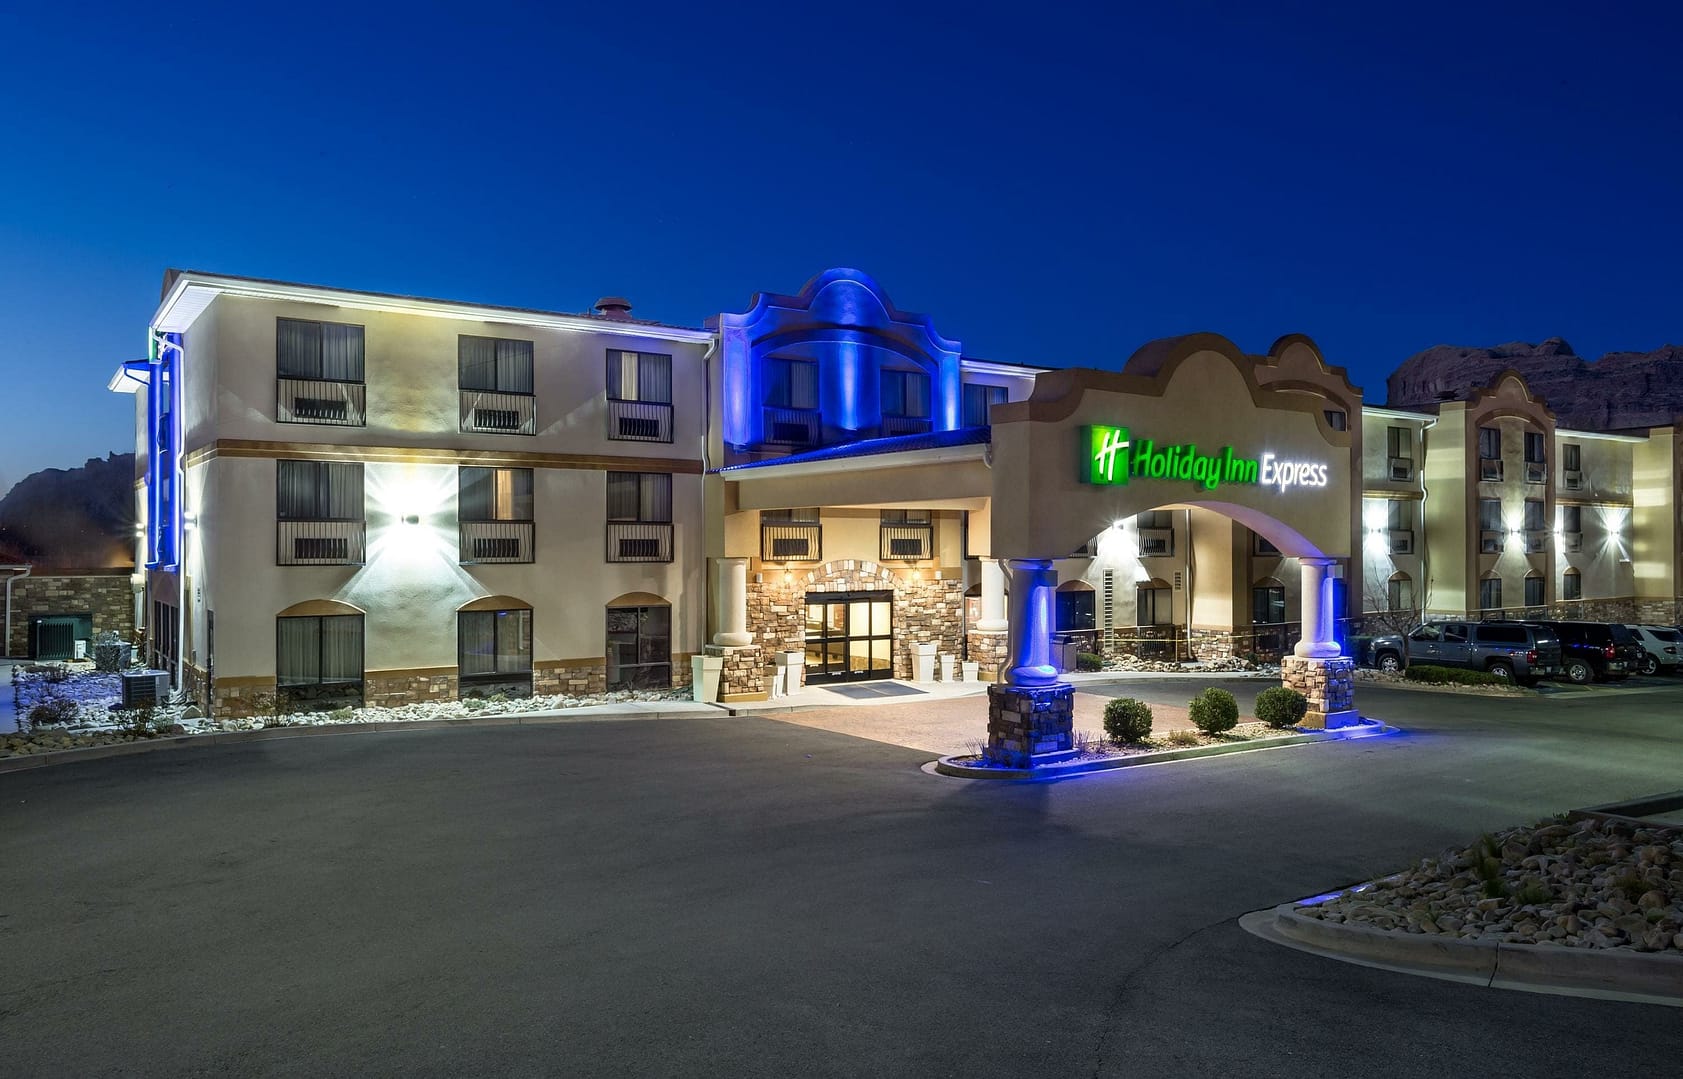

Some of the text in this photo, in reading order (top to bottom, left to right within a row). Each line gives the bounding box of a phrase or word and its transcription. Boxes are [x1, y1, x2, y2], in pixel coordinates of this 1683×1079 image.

[1094, 429, 1328, 493] H Holiday Inn Express
